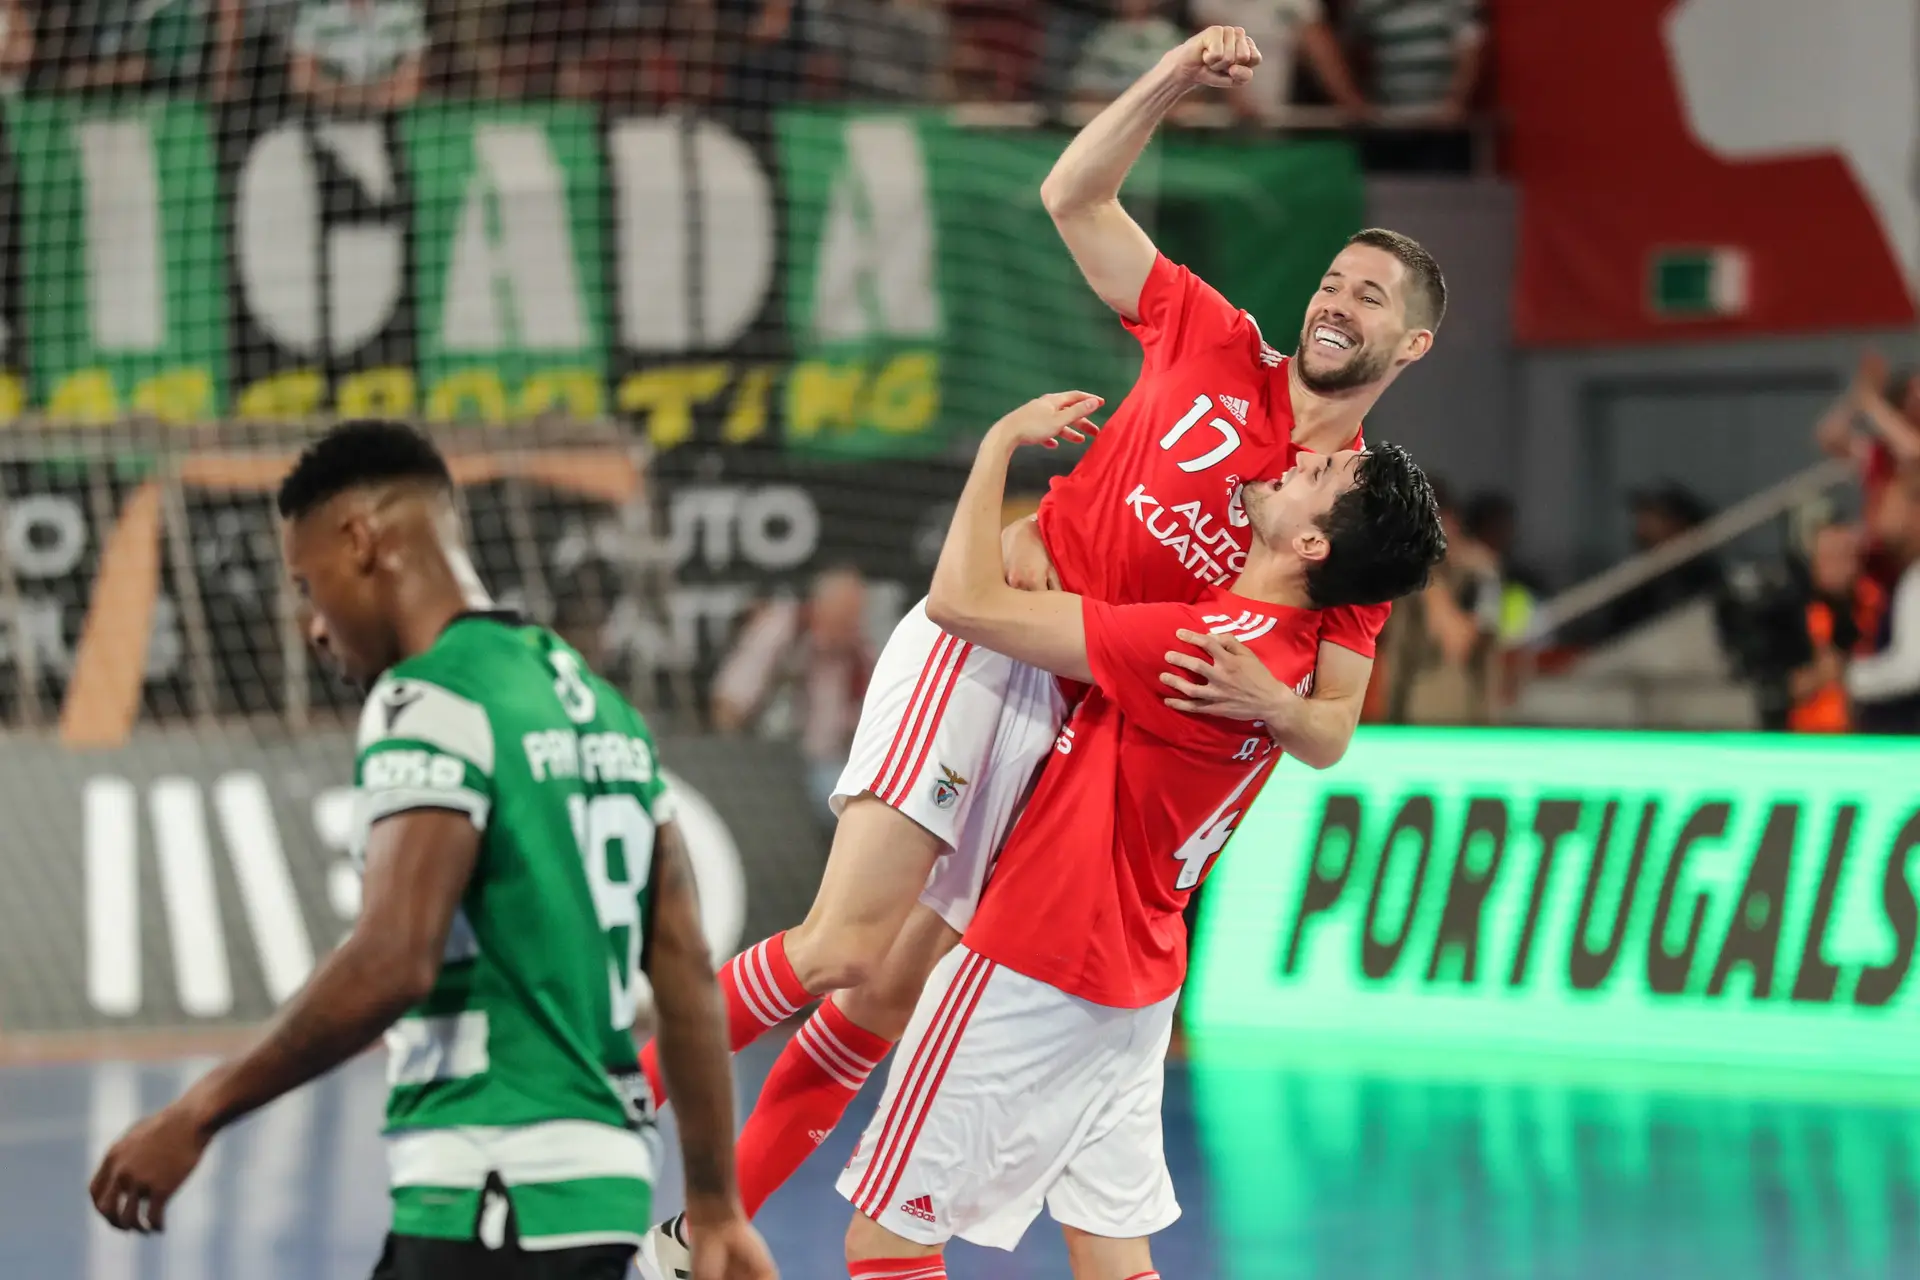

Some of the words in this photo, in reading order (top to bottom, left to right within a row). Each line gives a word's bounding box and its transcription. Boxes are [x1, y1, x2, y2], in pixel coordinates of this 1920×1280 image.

[0, 115, 940, 358] IGADA
[1159, 393, 1242, 474] 17
[1219, 394, 1248, 426] adidas
[1172, 754, 1272, 890] 4
[900, 1203, 937, 1223] adidas
